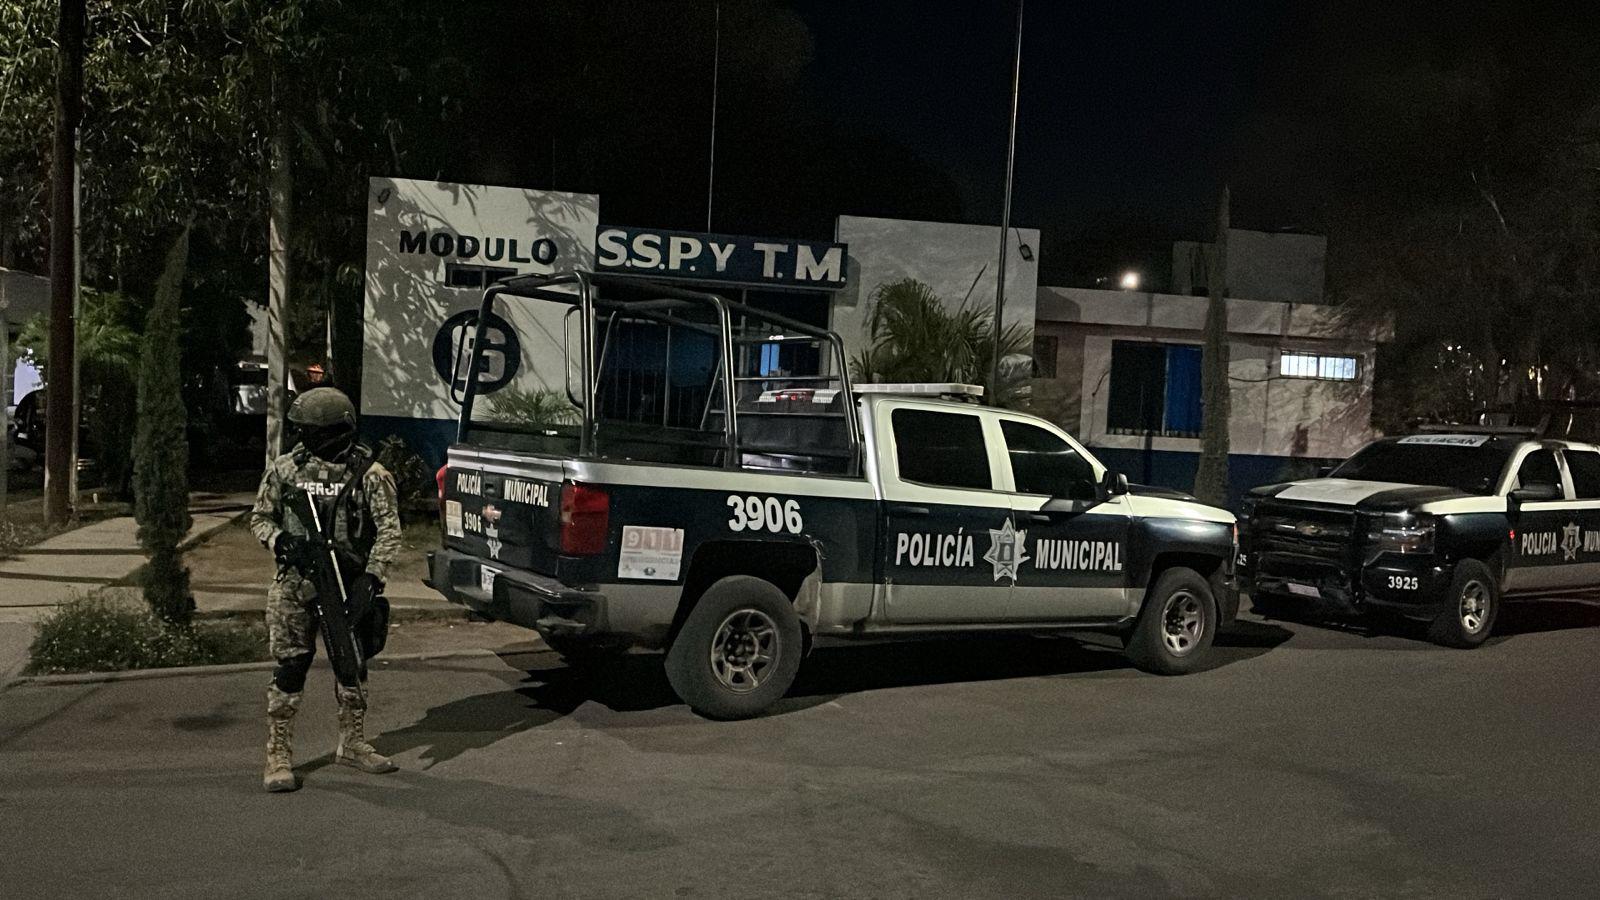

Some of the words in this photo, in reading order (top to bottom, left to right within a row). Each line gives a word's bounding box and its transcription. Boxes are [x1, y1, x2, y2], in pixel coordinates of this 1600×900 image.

[399, 230, 558, 266] MODULO
[708, 242, 736, 272] Y
[503, 479, 549, 508] MUNICIPAL
[464, 511, 482, 533] 3906
[726, 494, 803, 534] 3906
[627, 530, 678, 550] 911
[895, 526, 974, 567] POLICÍA
[1035, 538, 1123, 571] MUNICIPAL
[1388, 575, 1419, 590] 3925
